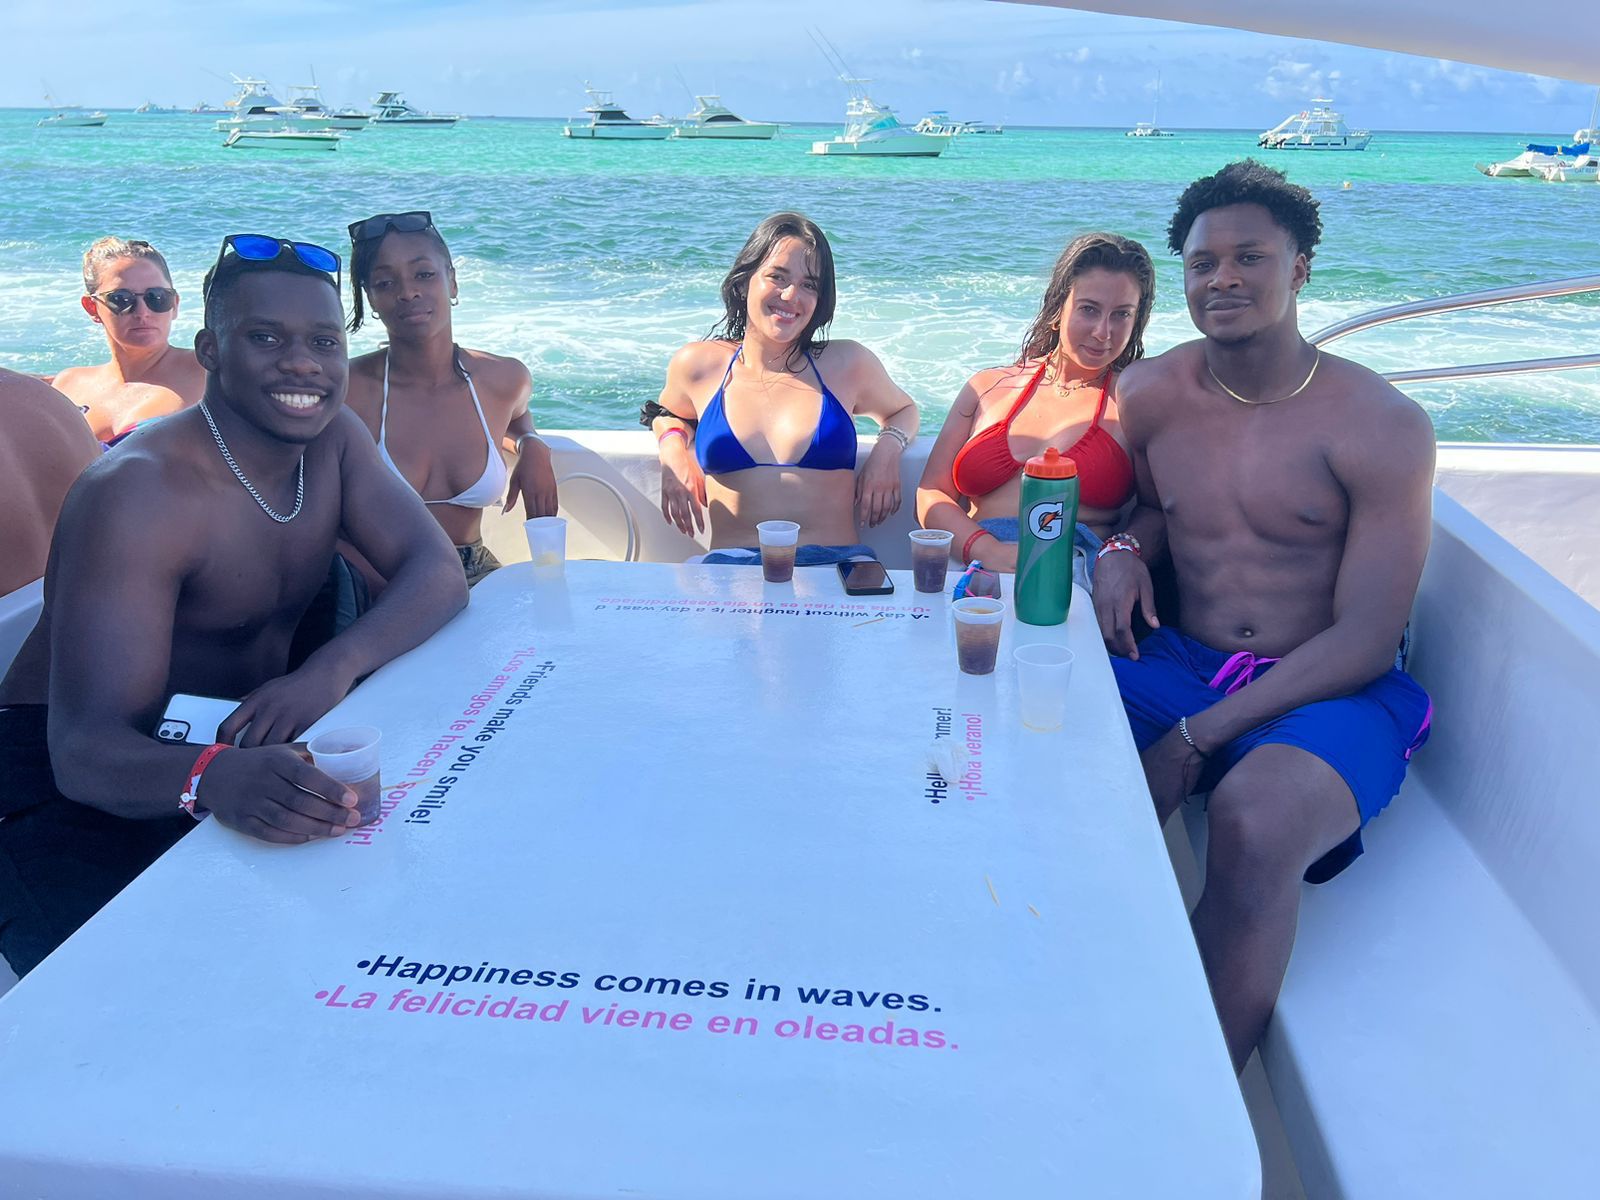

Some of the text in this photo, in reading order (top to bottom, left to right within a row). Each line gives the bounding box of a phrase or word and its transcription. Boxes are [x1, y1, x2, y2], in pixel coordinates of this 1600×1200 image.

[1028, 501, 1064, 541] G
[661, 605, 691, 613] day
[729, 608, 799, 616] laughter
[463, 674, 511, 716] amigos
[404, 664, 557, 824] Friends make you smile!
[449, 719, 476, 731] te
[407, 735, 464, 777] hacen
[367, 955, 943, 1014] Happiness comes in waves.
[325, 983, 960, 1051] La felicidad viene en oleadas.
